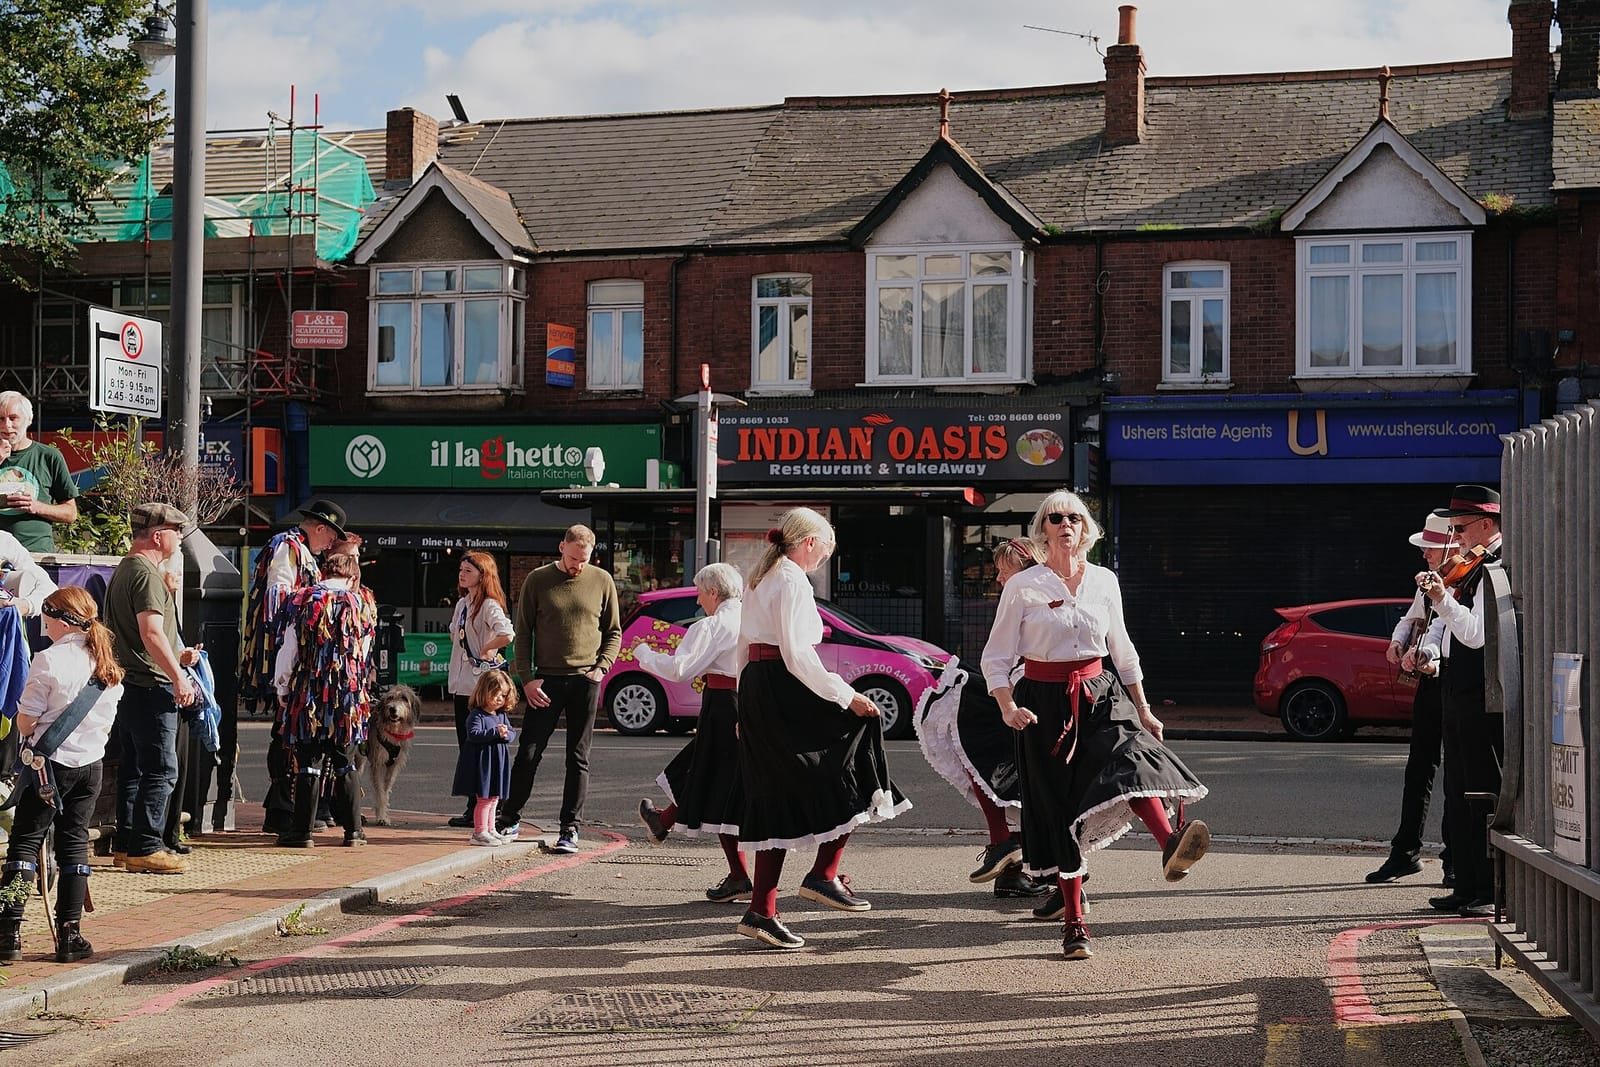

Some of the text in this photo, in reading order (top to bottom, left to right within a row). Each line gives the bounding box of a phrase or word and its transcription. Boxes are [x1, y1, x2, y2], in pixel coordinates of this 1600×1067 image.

[304, 315, 335, 325] L&R
[118, 366, 132, 377] Mon
[137, 369, 147, 379] Fri
[110, 378, 125, 389] 8.15
[129, 381, 144, 392] 9.15
[107, 390, 124, 401] 2.45
[129, 393, 145, 404] 3.45
[145, 398, 156, 406] pm
[968, 414, 985, 422] Tel:
[1009, 413, 1034, 421] 8669
[1036, 413, 1061, 421] 6699
[1121, 423, 1272, 442] Ushers Estate Agents
[1347, 421, 1496, 437] www.ushersuk.com
[197, 440, 232, 455] PEX
[737, 425, 1008, 461] INDIAN OASIS
[431, 435, 583, 479] il laghetto
[507, 468, 584, 479] Italian Kitchen
[769, 463, 986, 476] Restaurant & TakeAway
[378, 537, 397, 545] Grill
[422, 537, 509, 548] Dine-in & Takeaway
[858, 580, 891, 592] Oasis
[846, 664, 911, 685] 01372 700 444
[1552, 750, 1580, 775] ERMIT
